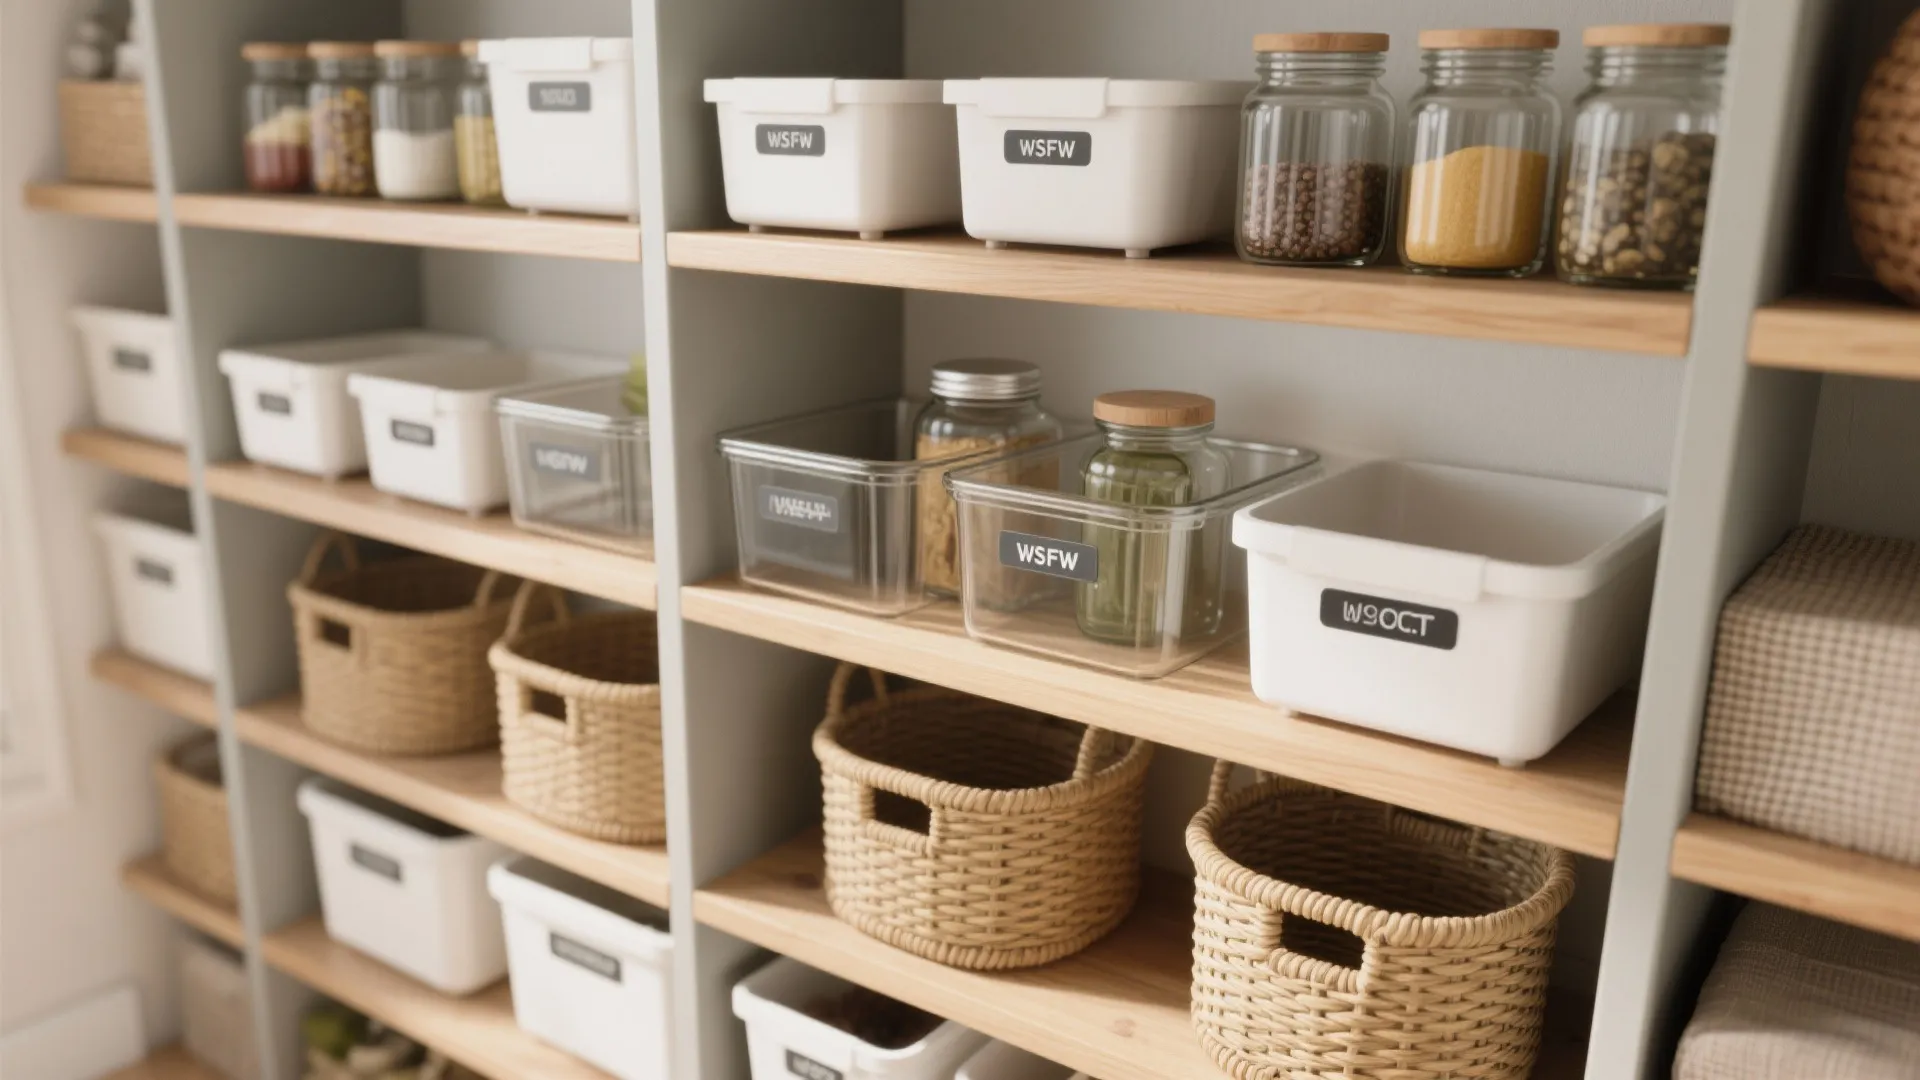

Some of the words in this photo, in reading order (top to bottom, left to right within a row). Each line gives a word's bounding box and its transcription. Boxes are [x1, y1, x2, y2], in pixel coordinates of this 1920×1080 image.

[767, 131, 813, 149] WSFW
[1019, 139, 1076, 159] WSFW
[1016, 542, 1079, 571] WSFW
